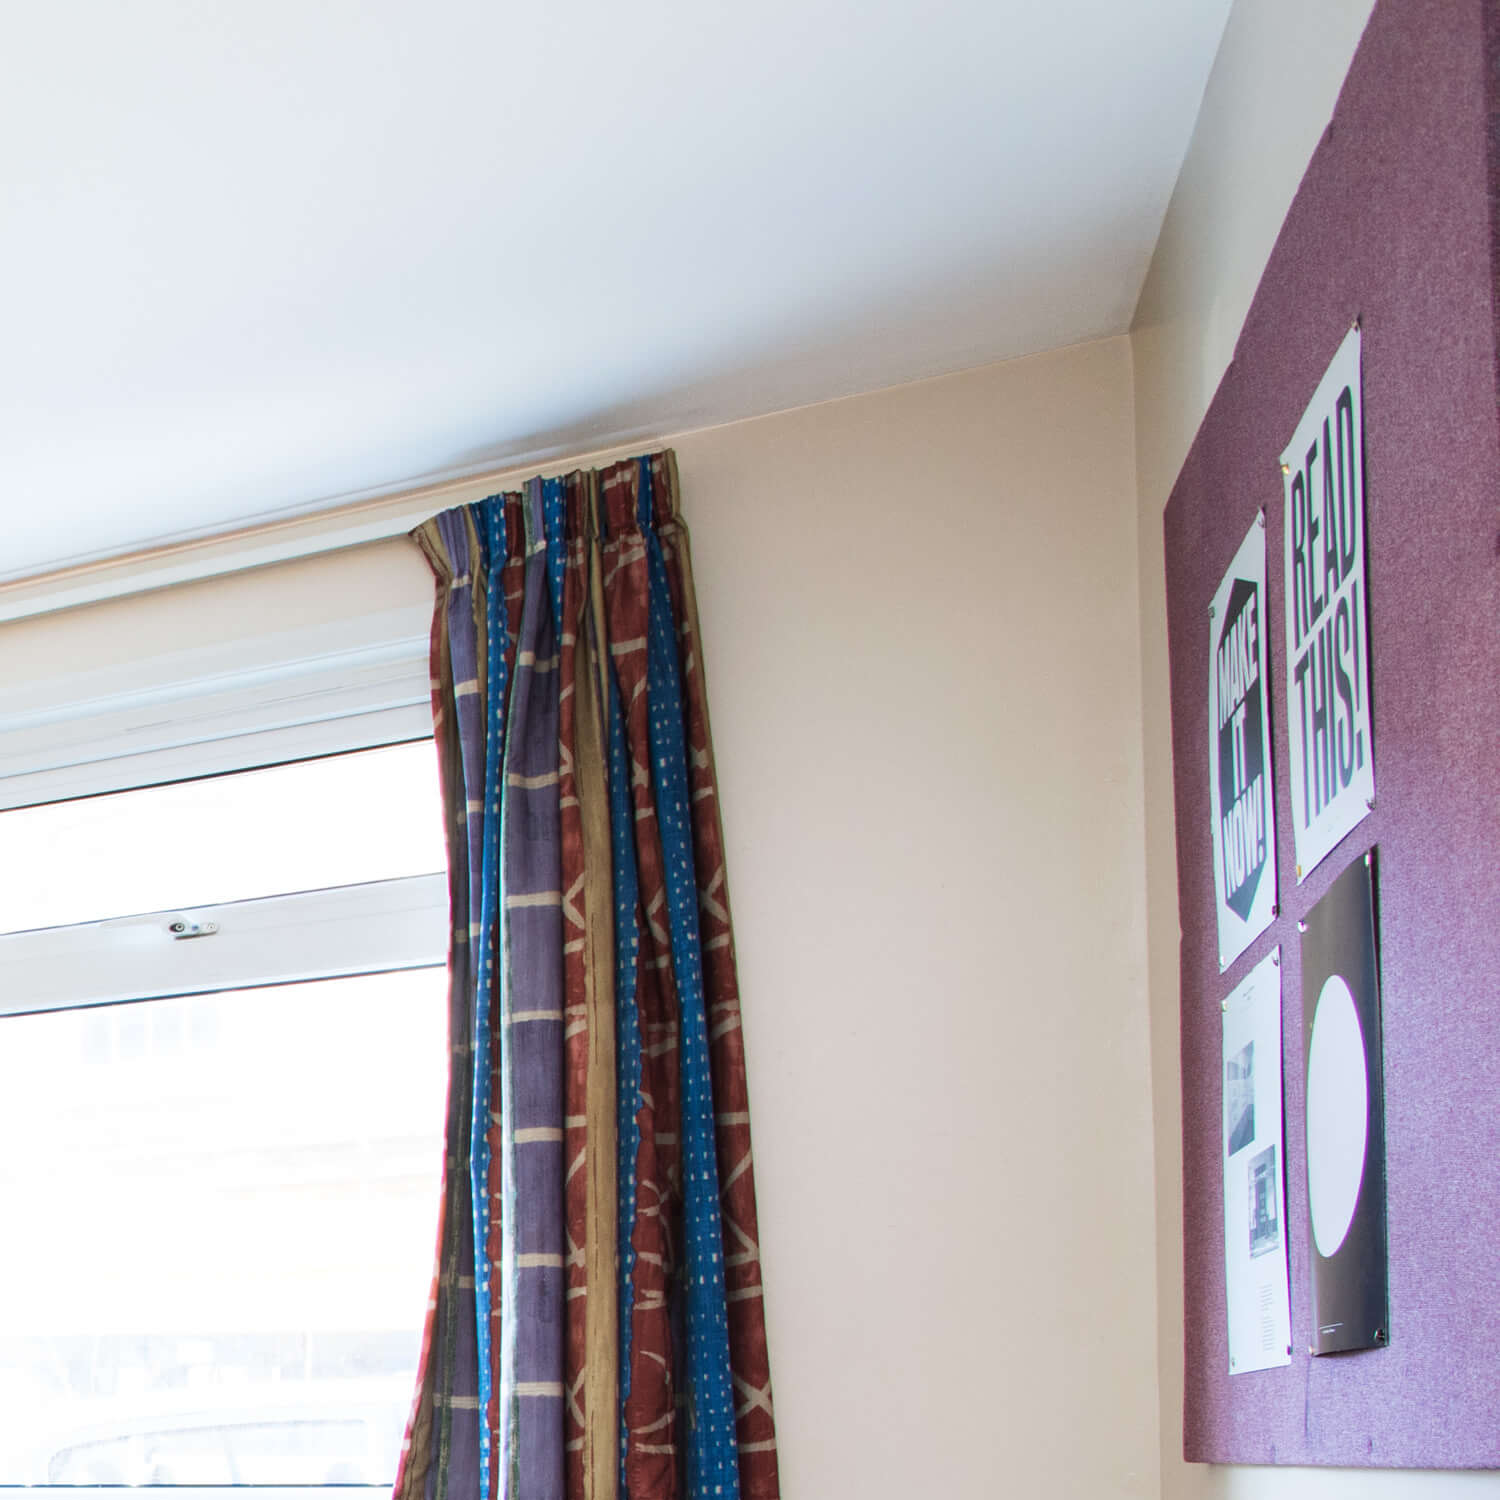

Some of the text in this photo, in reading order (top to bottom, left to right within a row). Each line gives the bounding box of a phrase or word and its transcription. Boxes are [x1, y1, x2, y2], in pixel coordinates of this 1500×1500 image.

[1291, 385, 1356, 652] READ
[1218, 591, 1258, 731] MAKE
[1294, 578, 1364, 829] THIS!
[1232, 700, 1247, 800] IT
[1223, 773, 1264, 899] NOW!
